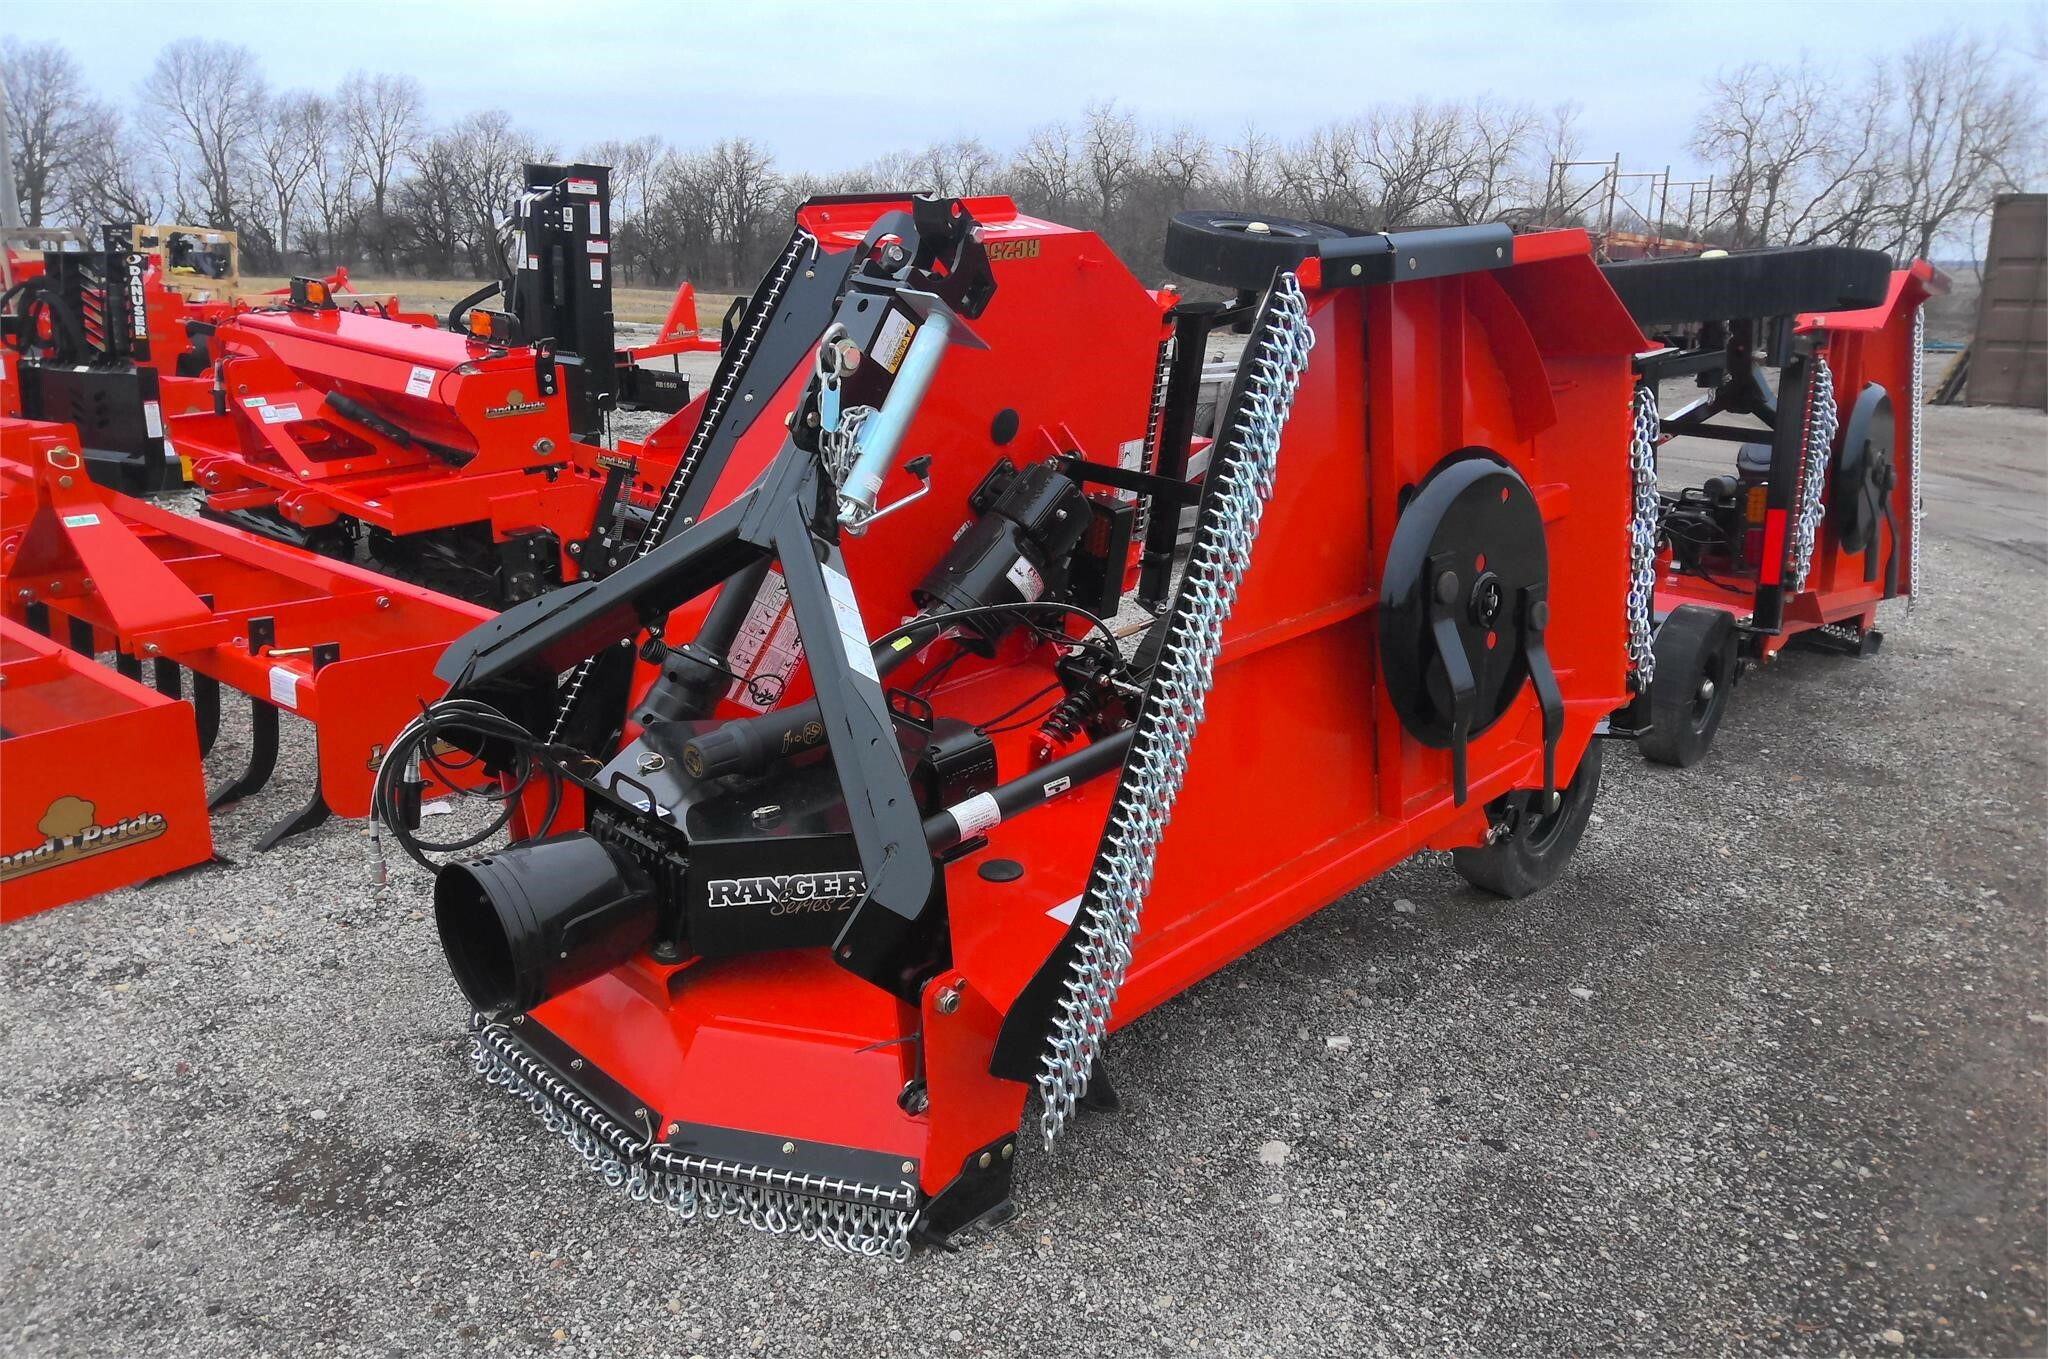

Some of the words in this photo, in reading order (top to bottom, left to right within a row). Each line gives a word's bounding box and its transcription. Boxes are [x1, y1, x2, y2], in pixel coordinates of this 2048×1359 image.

[128, 265, 147, 336] DANUSER
[890, 338, 908, 368] CAUTION
[484, 403, 511, 417] Land
[519, 401, 546, 413] Pride
[0, 835, 57, 872] and
[80, 811, 167, 851] Pride
[707, 870, 869, 908] RANGER
[770, 888, 833, 916] Series
[837, 889, 857, 912] 2
